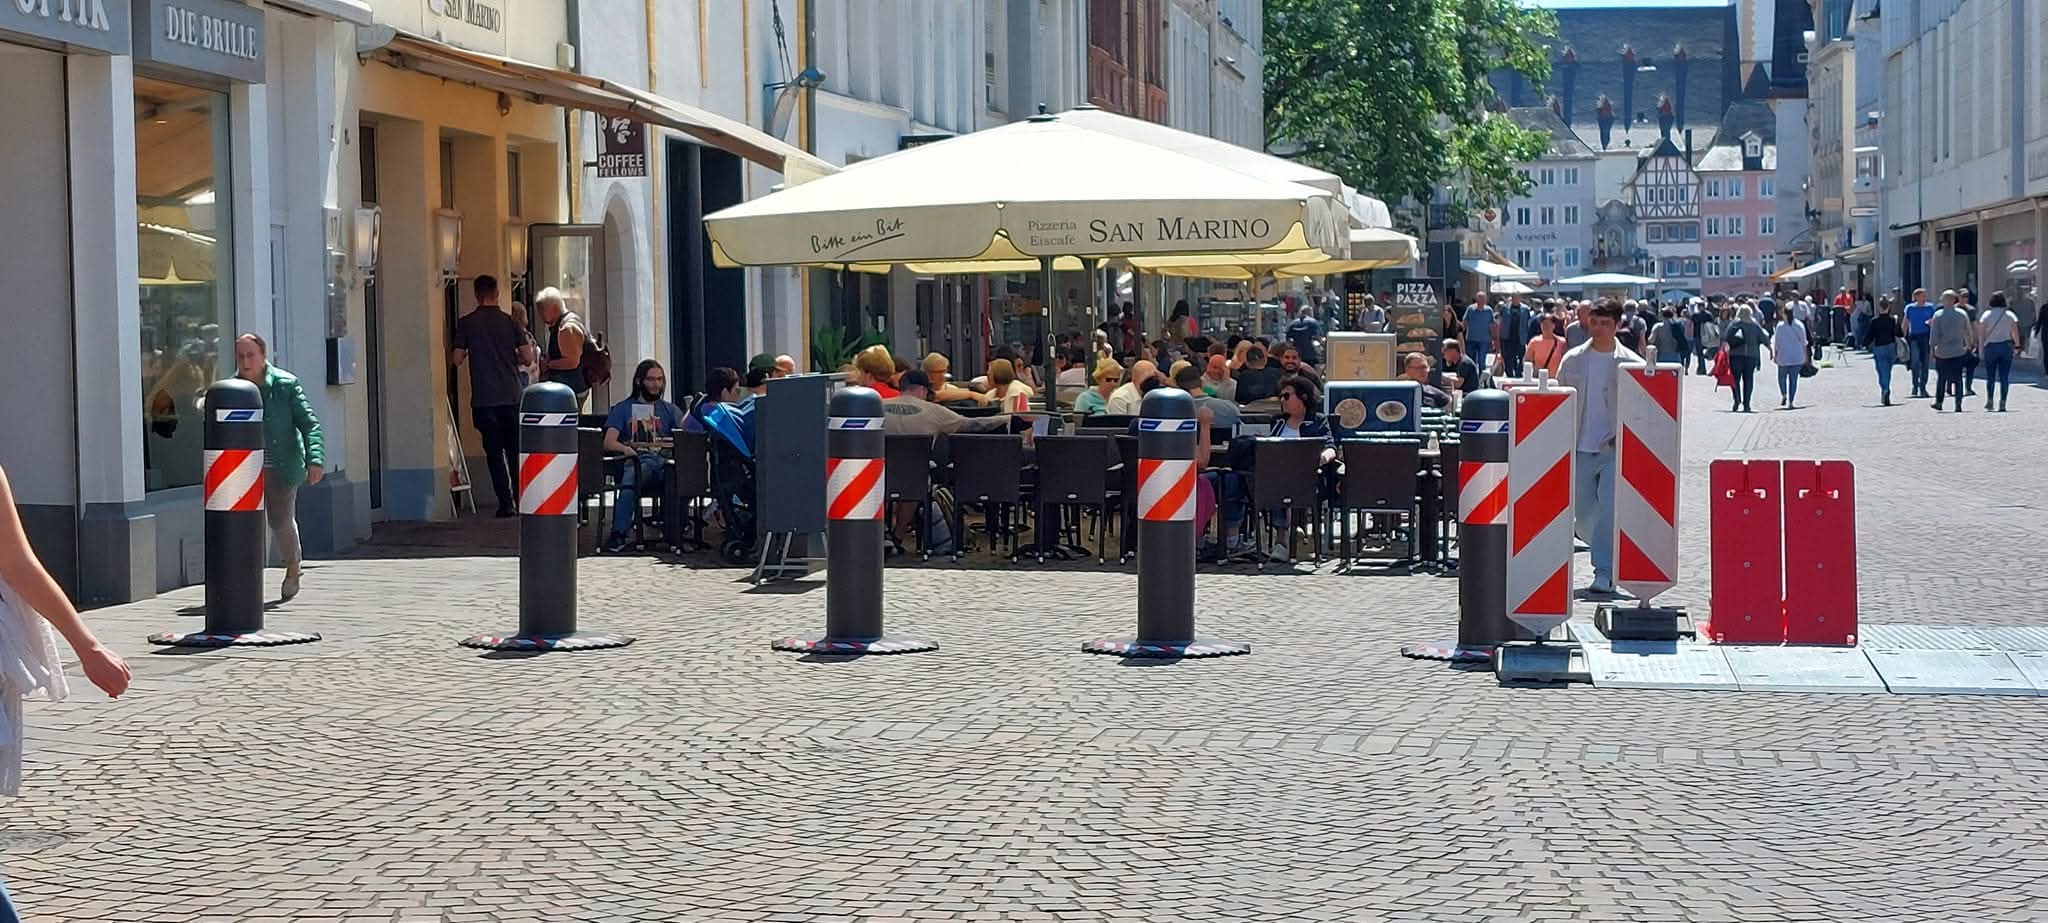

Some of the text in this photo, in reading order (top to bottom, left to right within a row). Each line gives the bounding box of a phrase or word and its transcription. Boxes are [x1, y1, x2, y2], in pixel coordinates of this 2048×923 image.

[445, 0, 501, 33] SAN MARINO
[167, 6, 259, 59] DIE BRILLE
[599, 153, 643, 168] COFFEE
[599, 167, 643, 176] FELLOWS
[1028, 220, 1077, 232] Pizzeria
[1089, 216, 1270, 243] SAN MARINO
[811, 217, 904, 253] Bitte ein Bit
[1397, 283, 1434, 293] PIZZA
[1397, 294, 1438, 307] PAZZA
